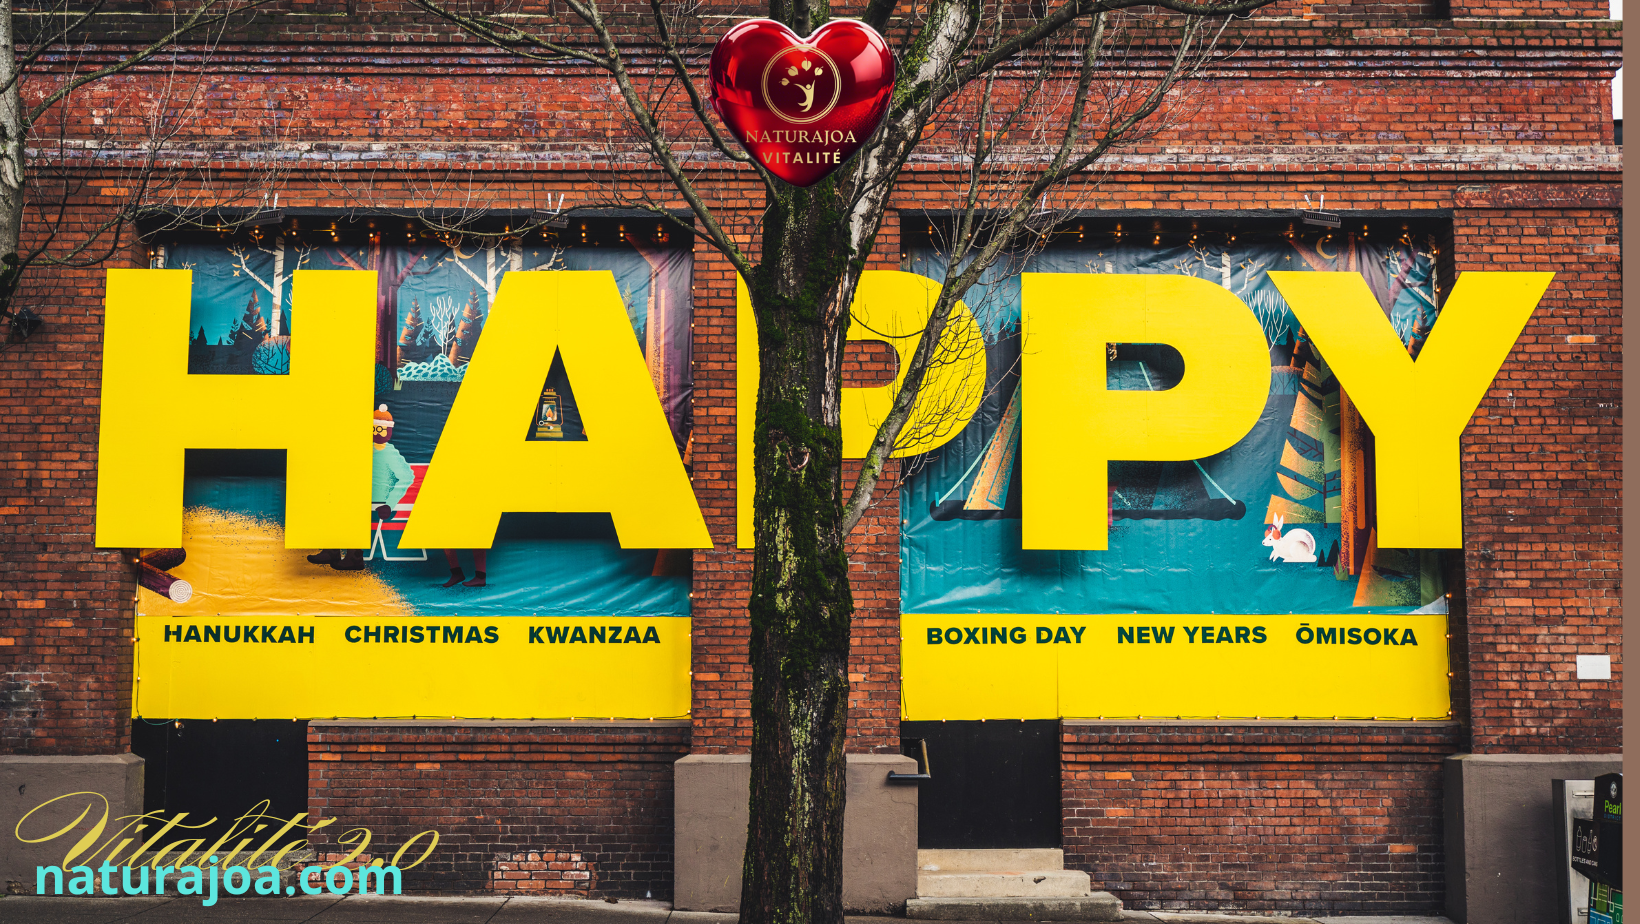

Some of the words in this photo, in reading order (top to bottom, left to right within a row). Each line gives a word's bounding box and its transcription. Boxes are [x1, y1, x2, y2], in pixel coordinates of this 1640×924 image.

[95, 268, 1556, 550] HAPPY
[163, 624, 315, 644] HANUKKAH
[344, 625, 500, 644] CHRISTMAS
[528, 625, 661, 644] KWANZAA
[926, 626, 1027, 645] BOXING
[1035, 626, 1087, 645] DAY
[1117, 626, 1176, 645] NEW
[1183, 626, 1268, 645] YEARS
[1295, 623, 1419, 646] ŌMISOKA
[1604, 799, 1622, 815] Pearl
